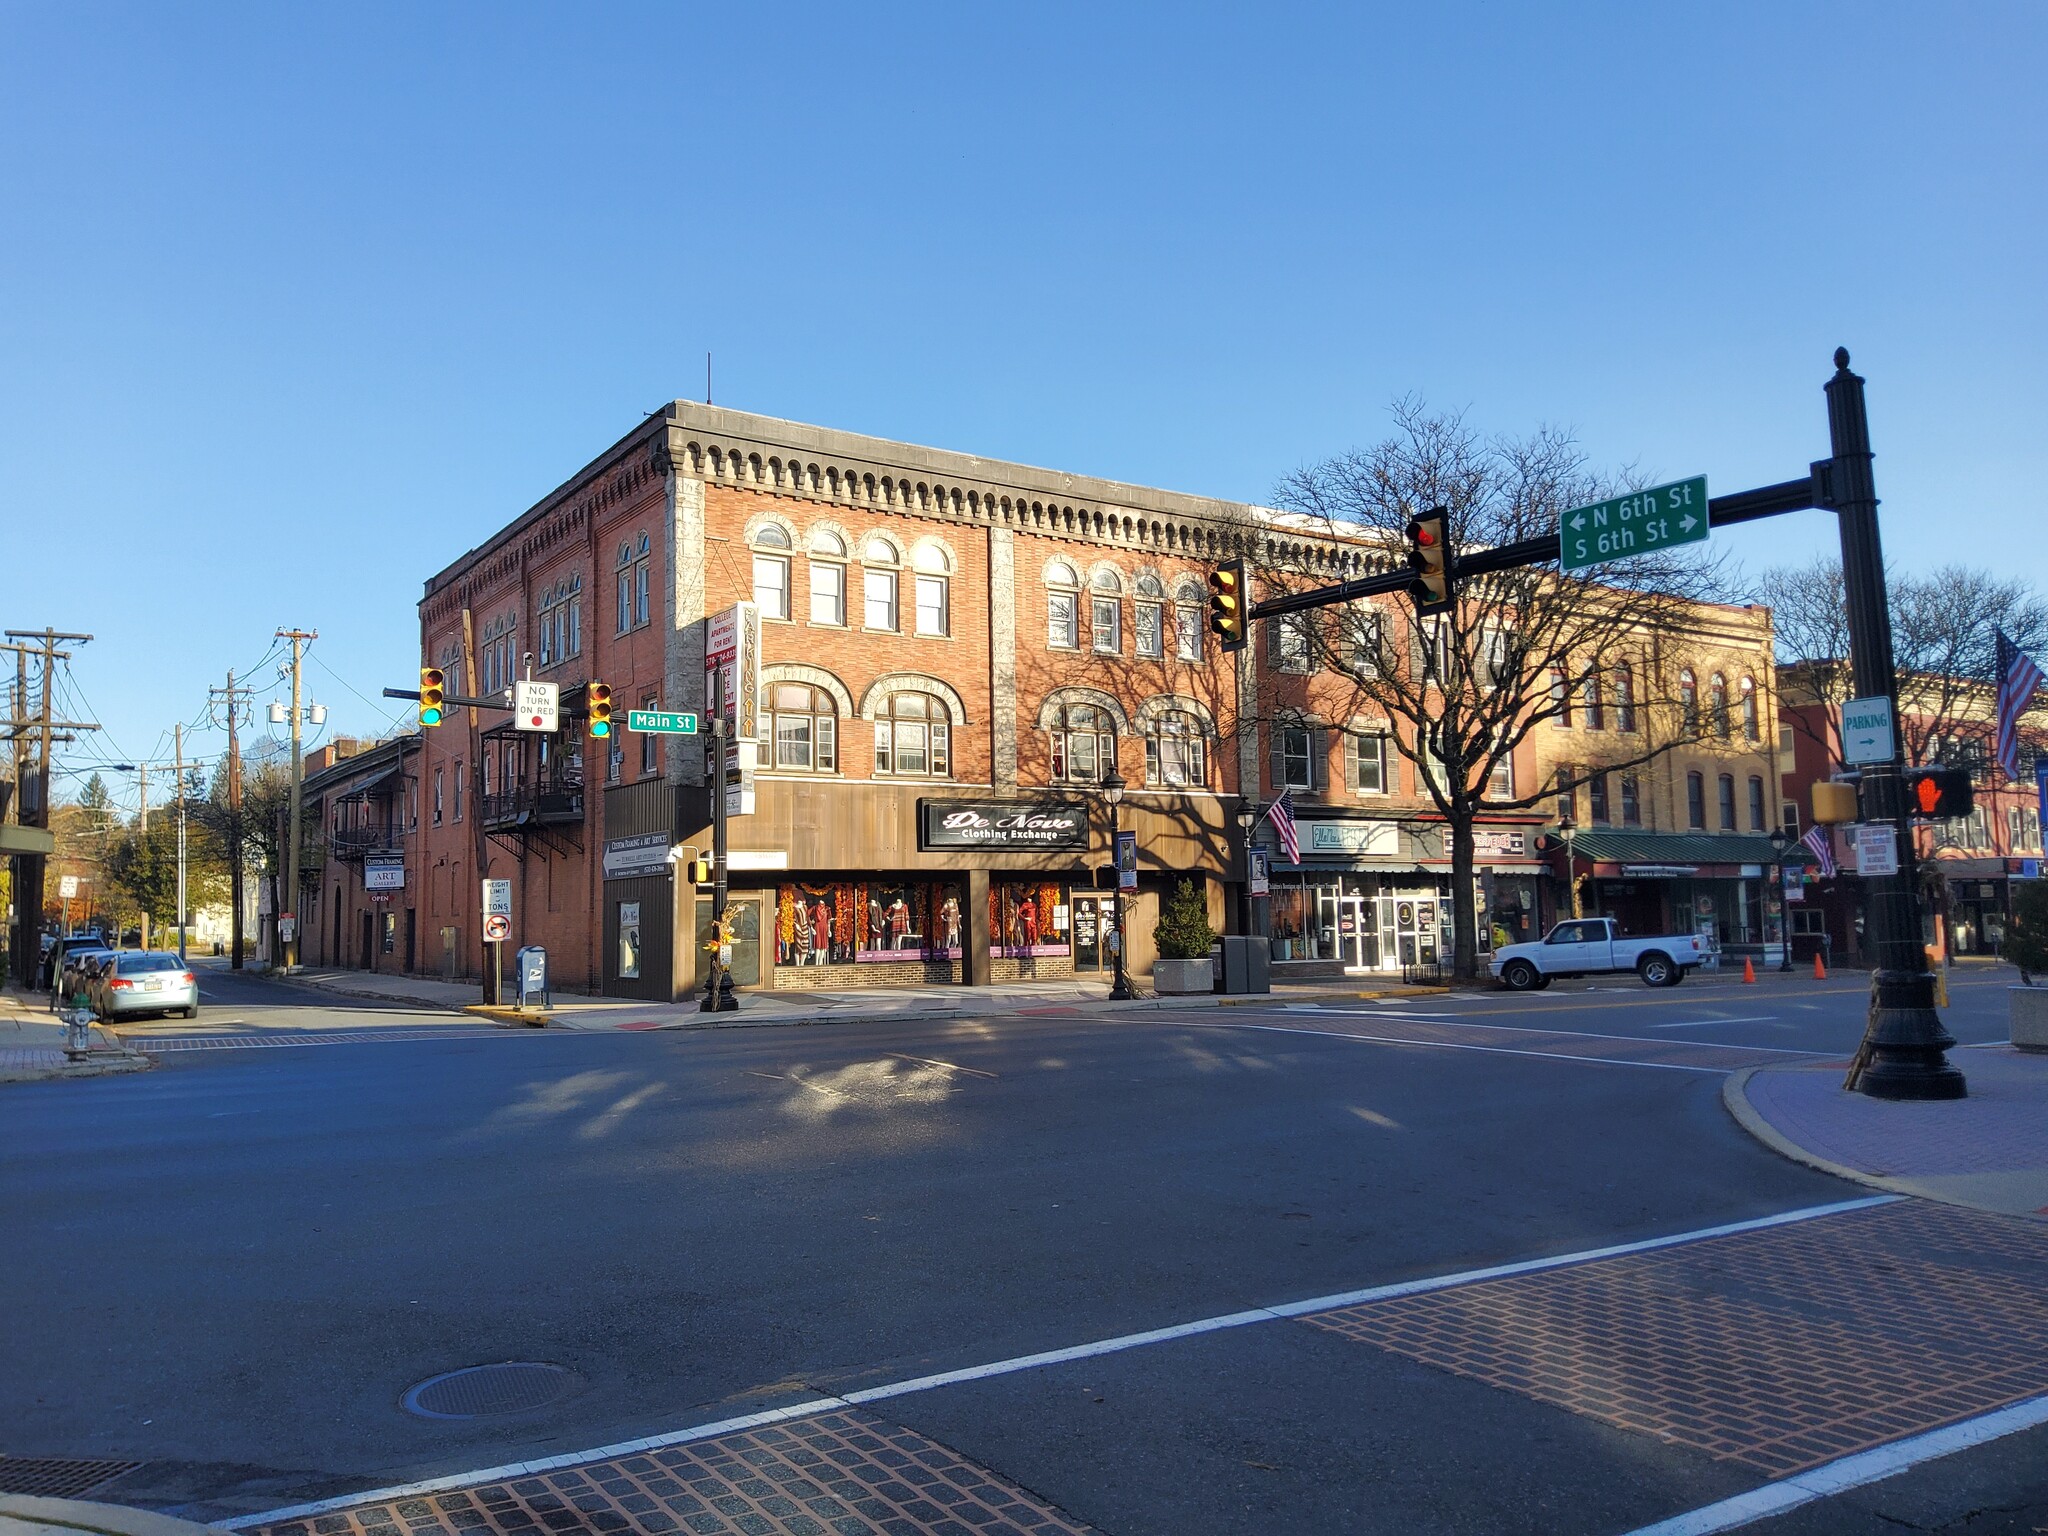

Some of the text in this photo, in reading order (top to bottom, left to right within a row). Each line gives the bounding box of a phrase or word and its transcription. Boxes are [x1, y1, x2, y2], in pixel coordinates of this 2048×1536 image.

[1593, 484, 1692, 528] N 6th St
[1575, 518, 1669, 559] S 6th St
[714, 611, 732, 625] COLLEGE
[711, 622, 735, 638] APARTMENTS
[714, 635, 733, 648] FOR RENT
[744, 607, 756, 694] PARKING
[529, 686, 547, 695] NO
[526, 697, 550, 705] TURN
[520, 706, 554, 715] ON RED
[636, 713, 670, 728] Main
[676, 716, 690, 729] St
[1845, 712, 1888, 731] PARKING
[942, 810, 1075, 829] De Novo
[961, 829, 1059, 841] Clothing Exchange
[611, 841, 625, 850] CUSTOM
[367, 858, 383, 866] CUSTOM
[375, 872, 396, 881] ART
[488, 903, 508, 911] TONS
